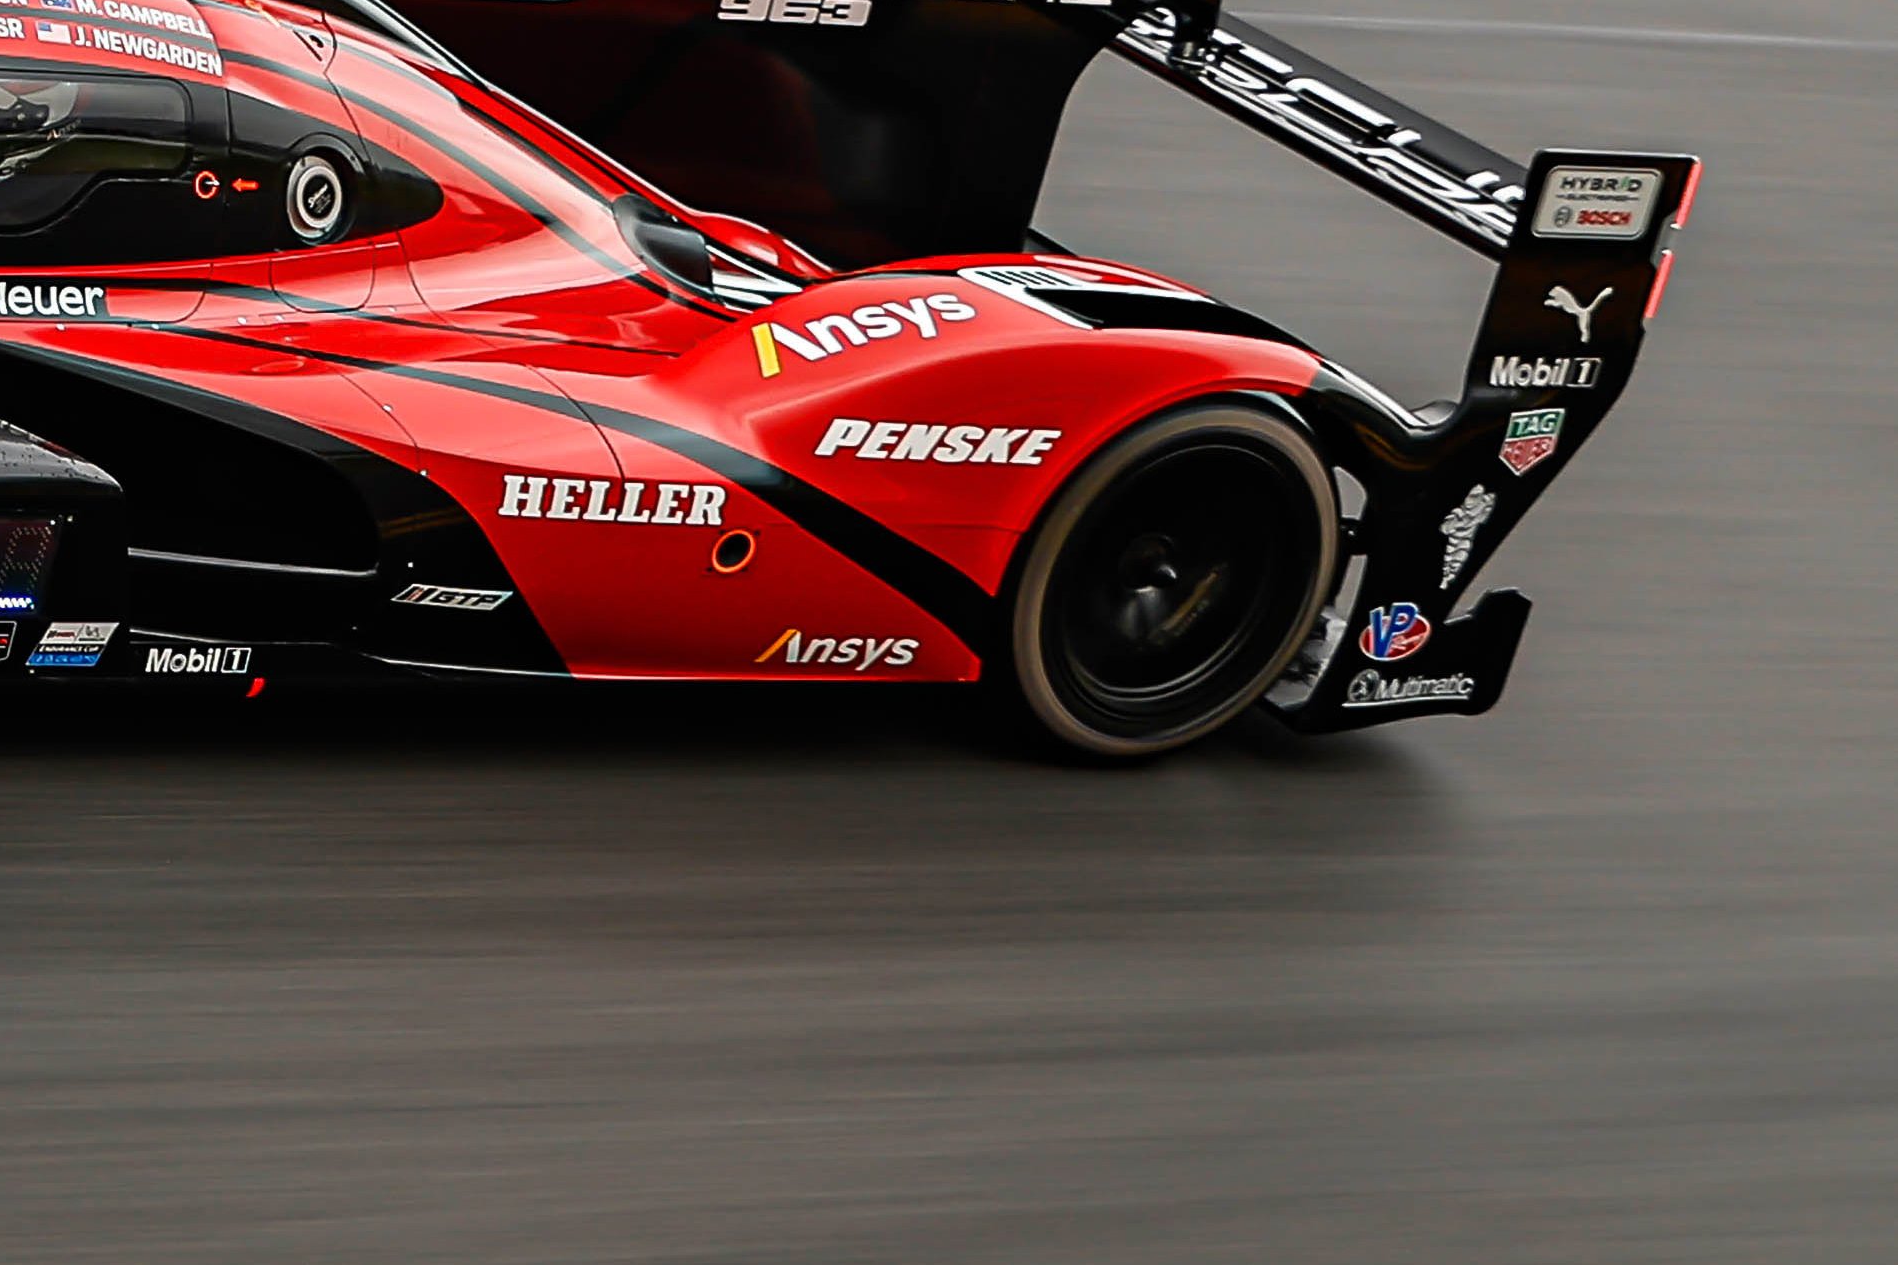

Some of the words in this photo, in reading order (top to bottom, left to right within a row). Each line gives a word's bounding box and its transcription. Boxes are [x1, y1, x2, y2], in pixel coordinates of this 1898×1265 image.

[106, 0, 214, 40] CAMPBELL
[96, 27, 224, 77] NEWGARDEN
[1576, 209, 1633, 226] BOSCH
[749, 293, 976, 378] Ansys
[1489, 356, 1569, 387] Mobil
[814, 417, 1062, 465] PENSKE
[1512, 414, 1556, 435] TAG
[498, 474, 725, 527] HELLER
[432, 591, 502, 608] GTP
[754, 628, 920, 670] Ansys
[1369, 602, 1418, 658] VP
[145, 647, 222, 674] Mobil
